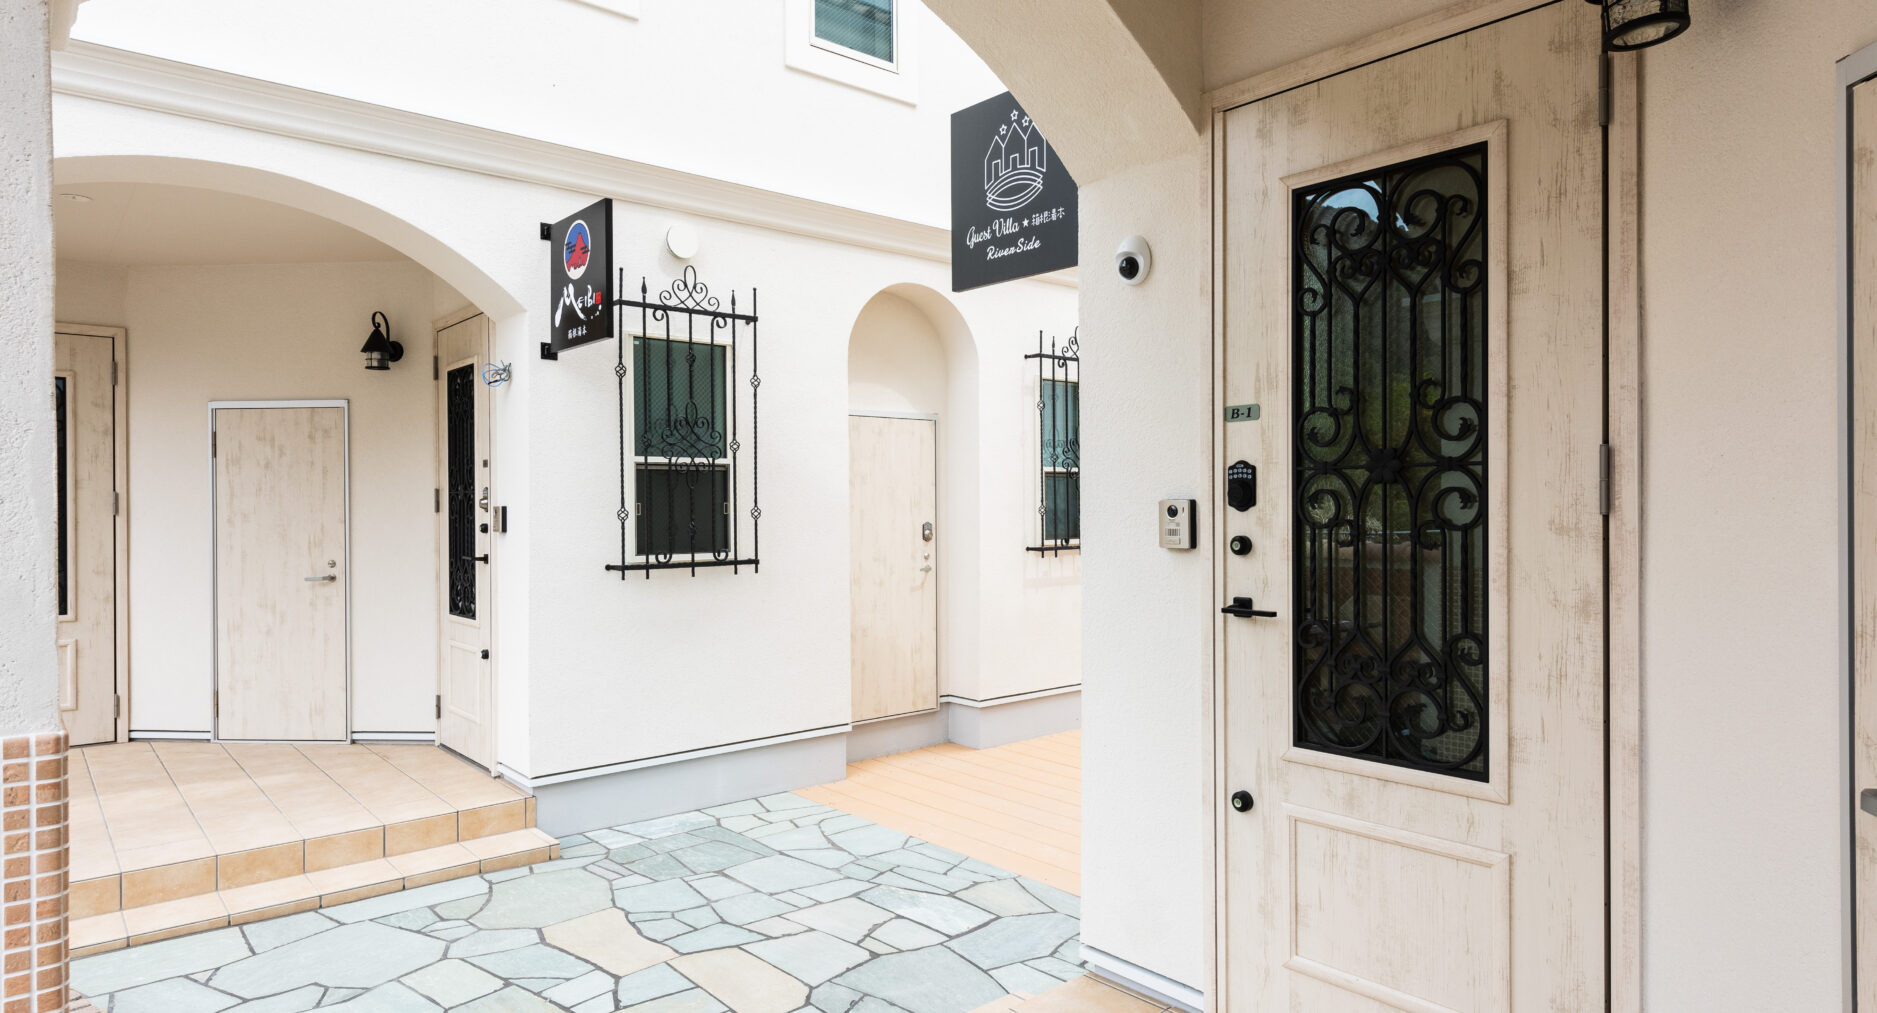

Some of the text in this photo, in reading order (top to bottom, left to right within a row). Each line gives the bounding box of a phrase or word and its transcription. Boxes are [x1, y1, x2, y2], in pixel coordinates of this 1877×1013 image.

[966, 226, 992, 249] Guest
[992, 217, 1020, 237] Villa
[1230, 406, 1253, 420] B-1
